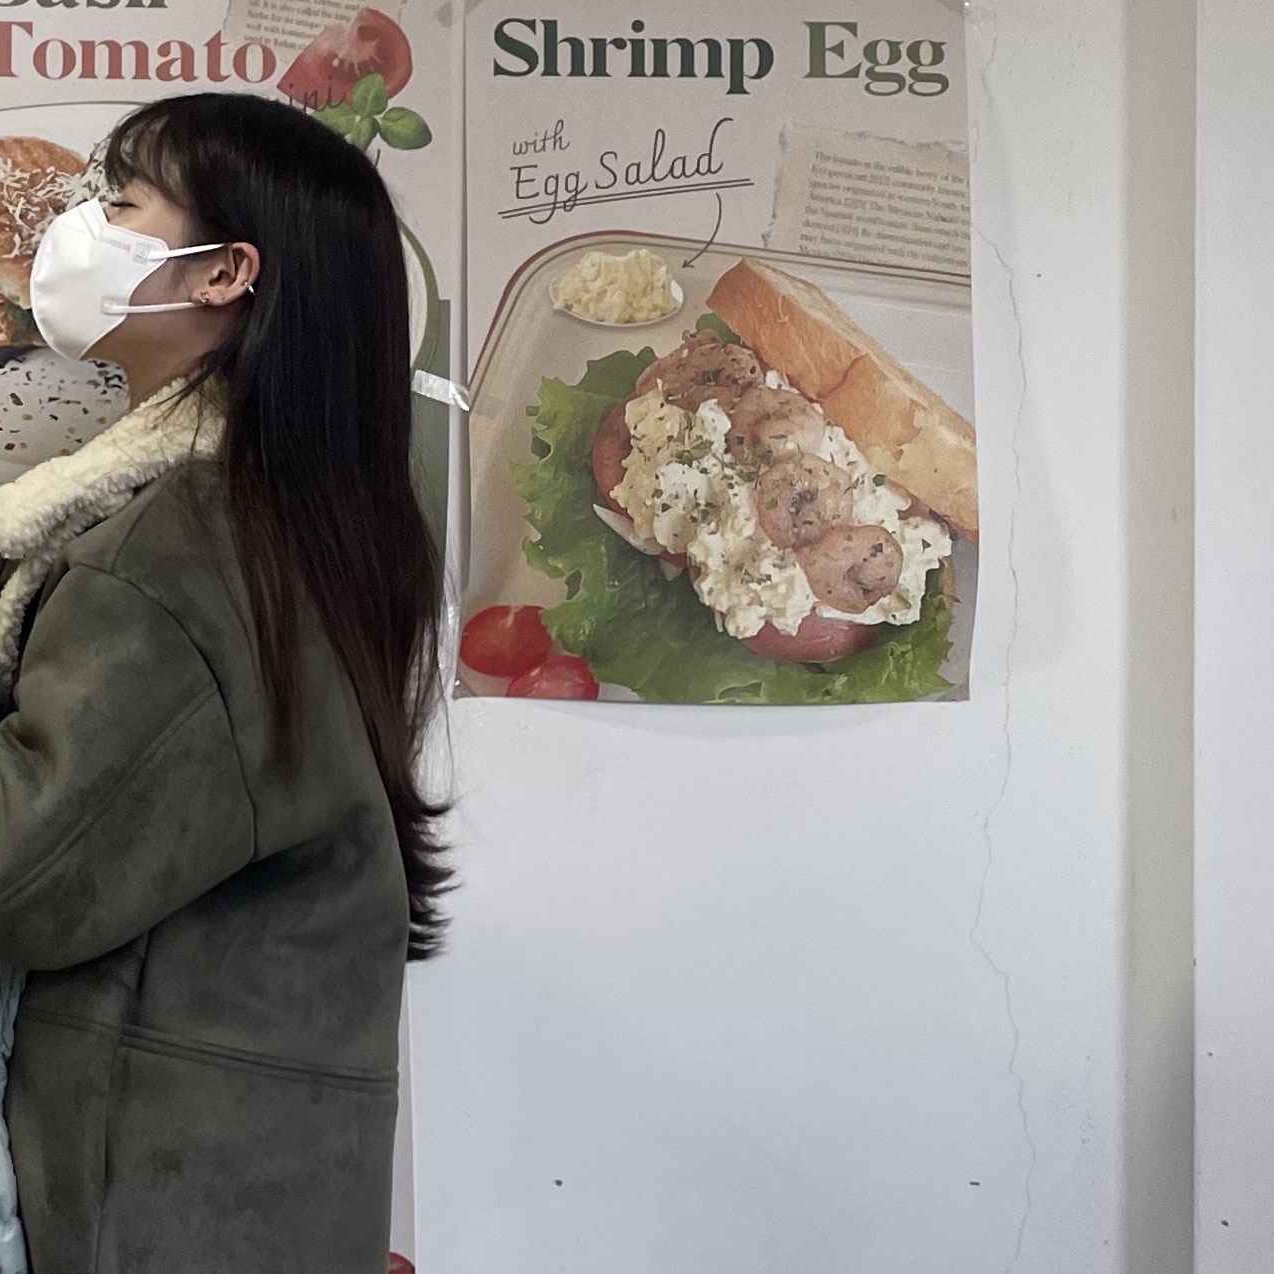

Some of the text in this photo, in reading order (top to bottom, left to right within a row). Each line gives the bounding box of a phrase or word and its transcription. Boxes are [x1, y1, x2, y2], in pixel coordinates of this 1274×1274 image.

[493, 17, 950, 97] Shrimp Egg
[510, 118, 734, 224] Egg Salad
[512, 119, 571, 157] with
